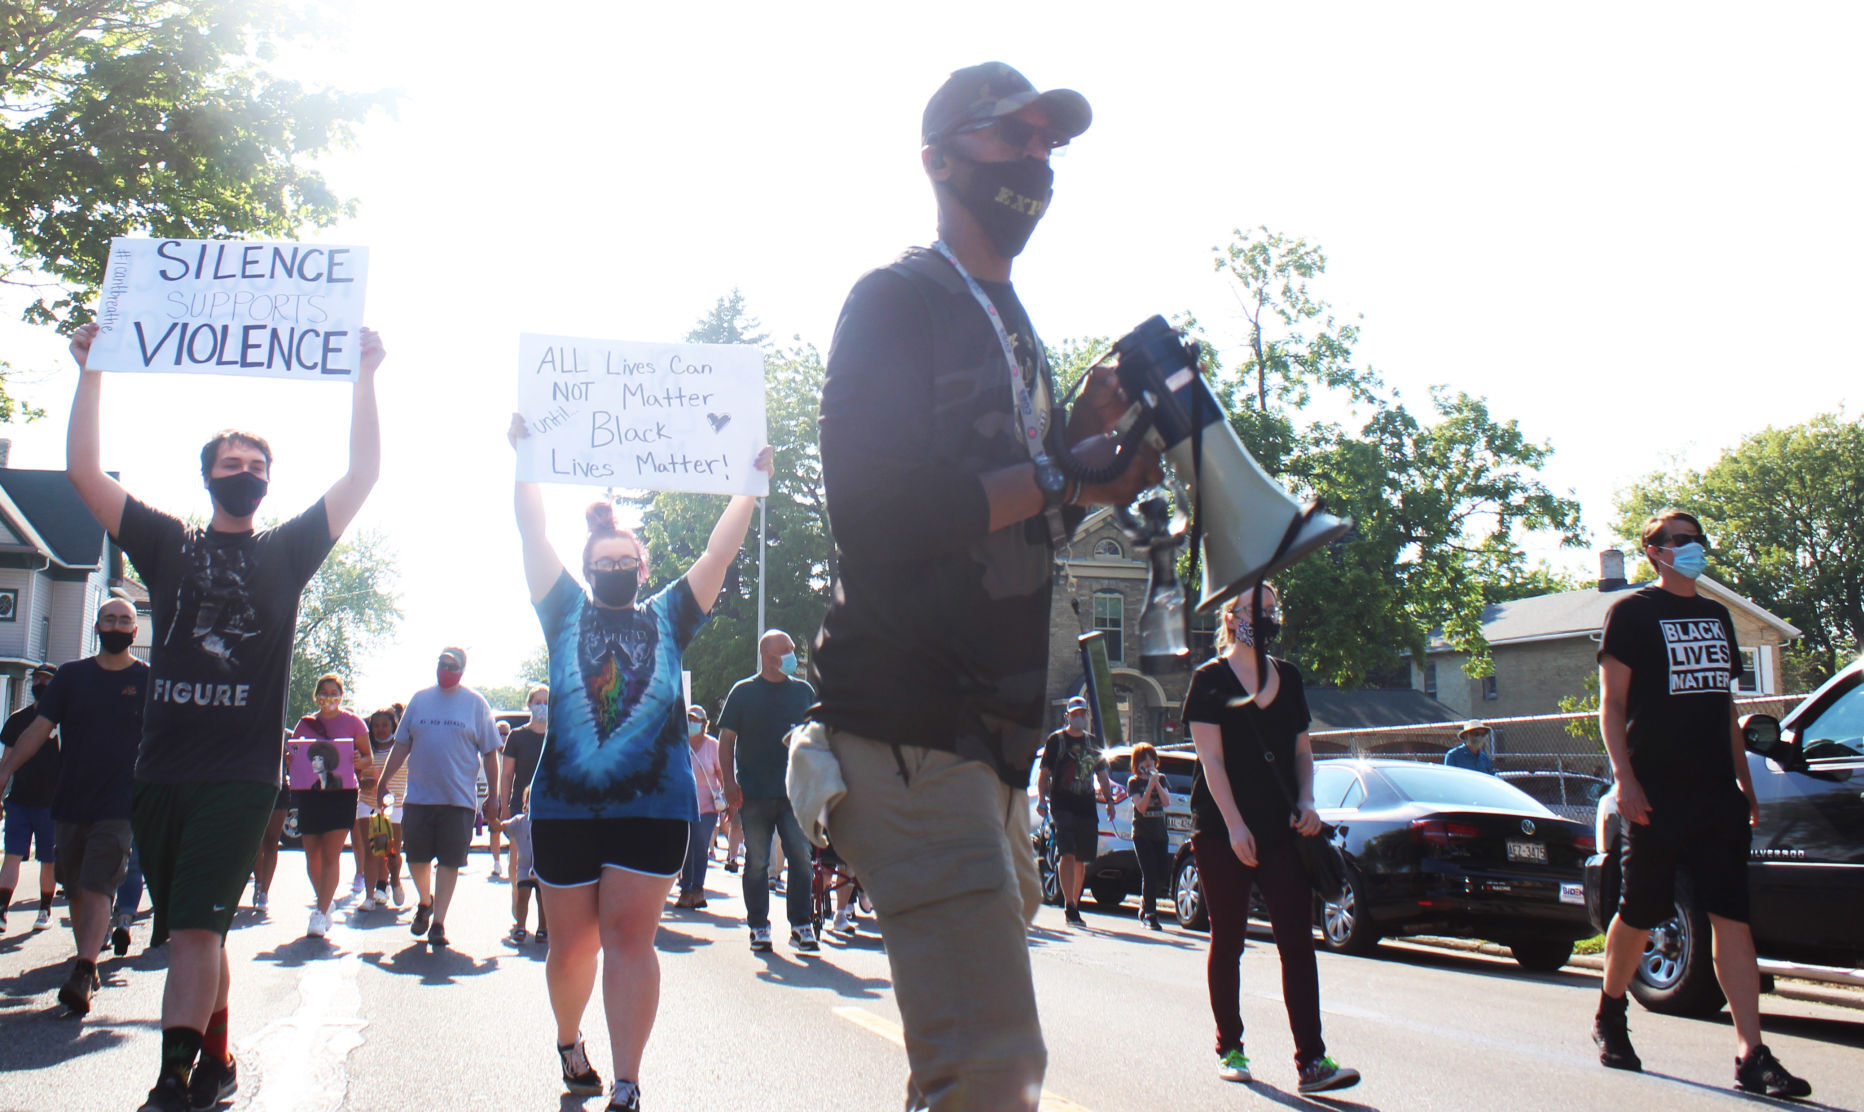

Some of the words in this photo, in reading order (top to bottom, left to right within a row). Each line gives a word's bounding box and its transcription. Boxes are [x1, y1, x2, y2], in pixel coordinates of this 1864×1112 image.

[157, 240, 354, 283] SILENCE
[166, 291, 327, 323] SUPPORTS
[134, 321, 352, 375] VIOLENCE
[536, 346, 589, 374] ALL
[606, 351, 656, 375] Lives
[670, 355, 713, 375] Can
[552, 381, 595, 402] NOT
[623, 383, 714, 410] Matter
[591, 410, 673, 448] Black
[551, 448, 615, 478] Lives
[636, 451, 729, 481] Matter!
[1662, 622, 1726, 641] BLACK
[1670, 644, 1730, 666] LIVES
[153, 678, 250, 707] FIGURE
[1671, 671, 1730, 690] MATTER
[1750, 849, 1805, 858] ILVERADO
